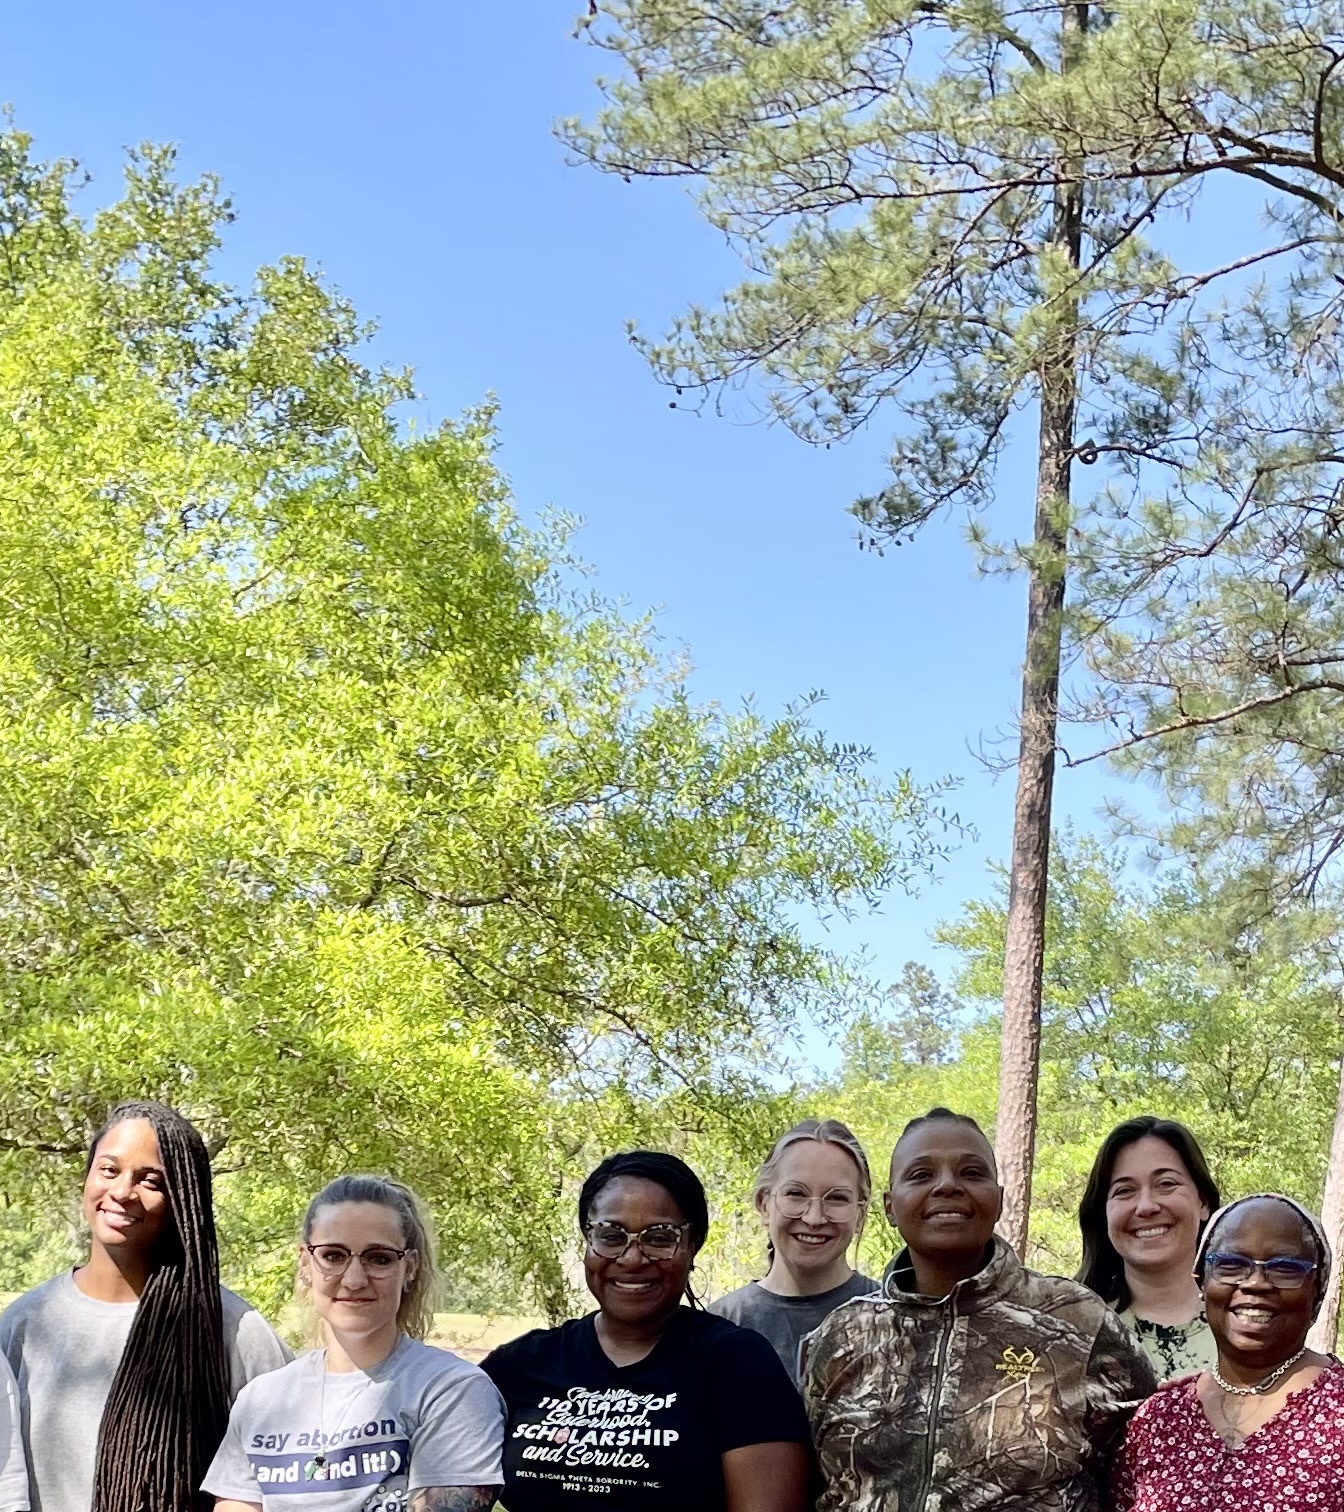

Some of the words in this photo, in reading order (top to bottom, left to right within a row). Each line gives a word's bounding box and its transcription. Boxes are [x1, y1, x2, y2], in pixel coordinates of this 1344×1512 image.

[538, 1397, 572, 1411] 110
[575, 1397, 639, 1416] YEARS
[645, 1393, 677, 1410] OF
[251, 1432, 290, 1452] say
[296, 1419, 395, 1448] abortion
[522, 1444, 567, 1463] and
[565, 1445, 650, 1469] Service.
[516, 1470, 537, 1479] DELTA
[539, 1472, 566, 1481] SIGMA
[568, 1474, 593, 1483] THETA
[587, 1484, 611, 1494] 2023
